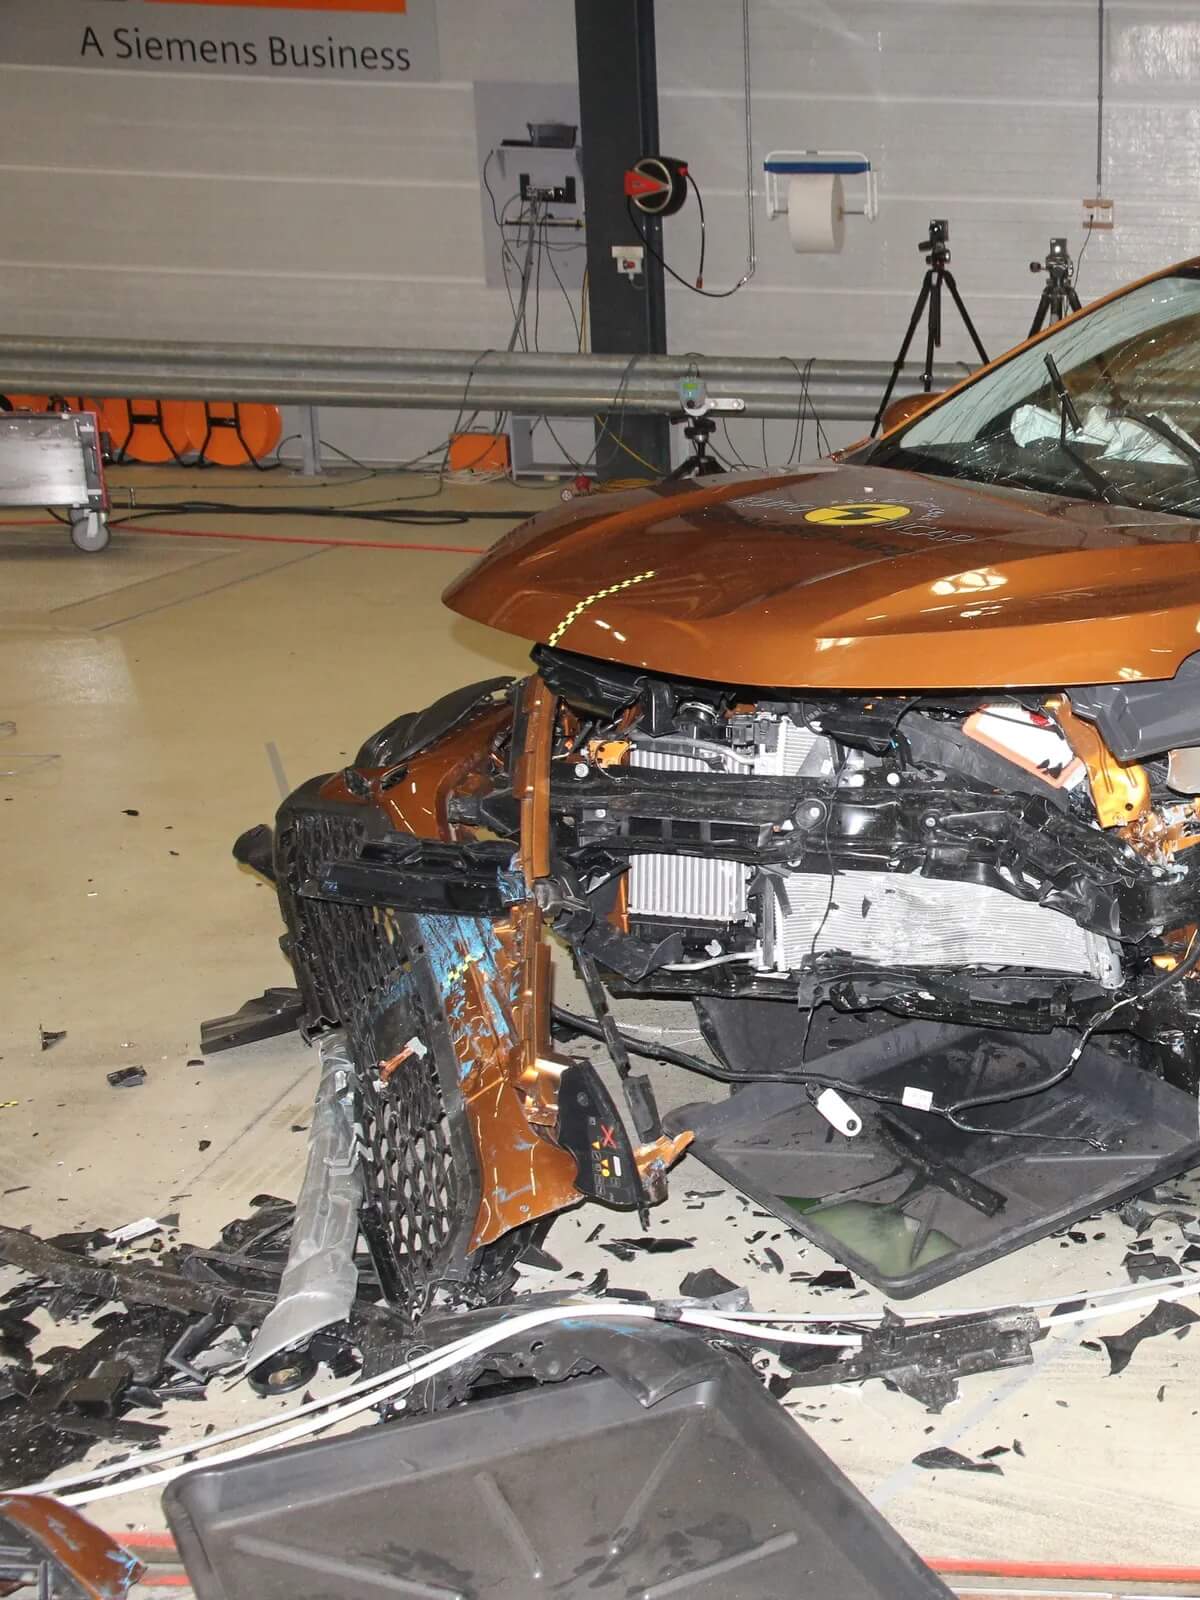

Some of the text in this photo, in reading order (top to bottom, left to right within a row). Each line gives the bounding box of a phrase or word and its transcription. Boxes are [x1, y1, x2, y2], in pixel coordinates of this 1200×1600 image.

[80, 26, 412, 71] A Siemens Business
[872, 520, 977, 542] NCAP
